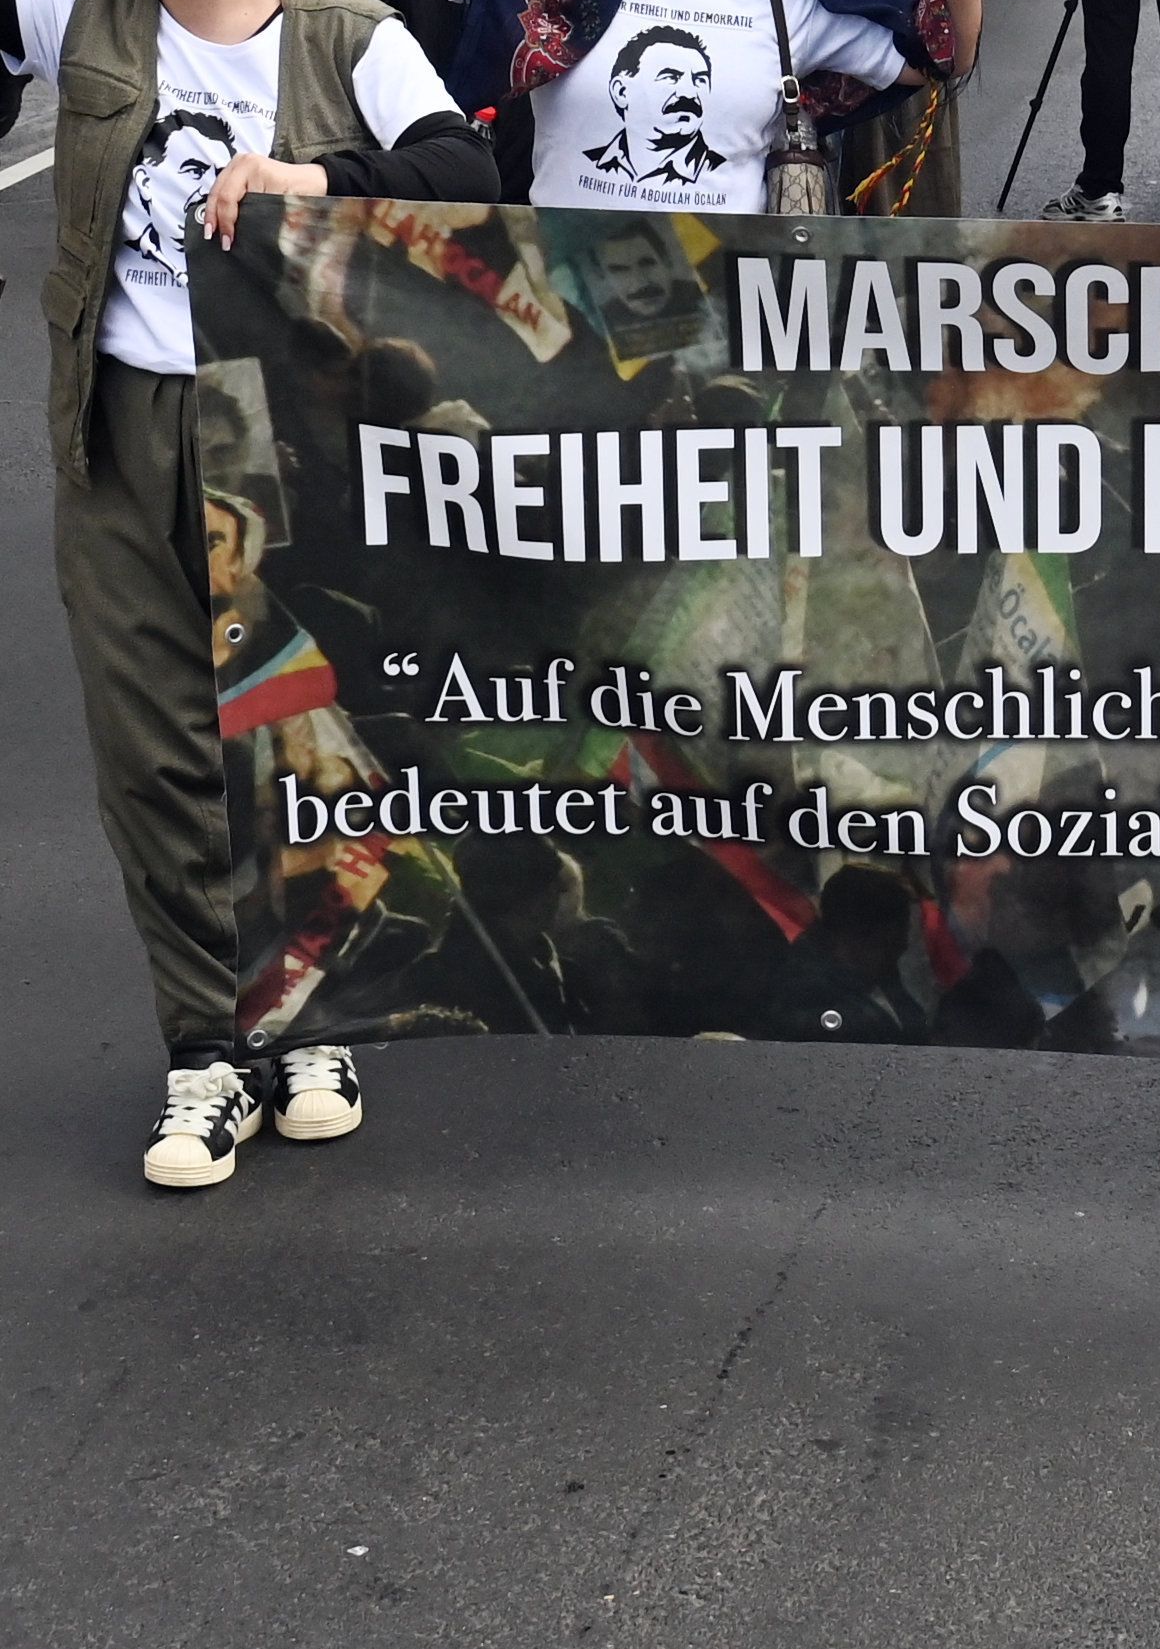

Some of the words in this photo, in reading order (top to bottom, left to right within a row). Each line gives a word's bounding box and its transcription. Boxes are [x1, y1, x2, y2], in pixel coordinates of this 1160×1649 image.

[628, 3, 668, 19] FREIHEIT
[670, 9, 691, 23] UND
[692, 11, 753, 29] DEMOKRATIE
[578, 175, 615, 197] FREIHEIT
[618, 182, 638, 200] FÜR
[640, 187, 691, 206] ABDULLAH
[124, 267, 168, 287] FREIHEIT
[357, 423, 842, 563] FREIHEIT
[877, 423, 1103, 555] UND
[590, 666, 704, 737] die
[279, 767, 629, 845] bedeutet
[650, 782, 773, 843] auf
[789, 786, 930, 856] den
